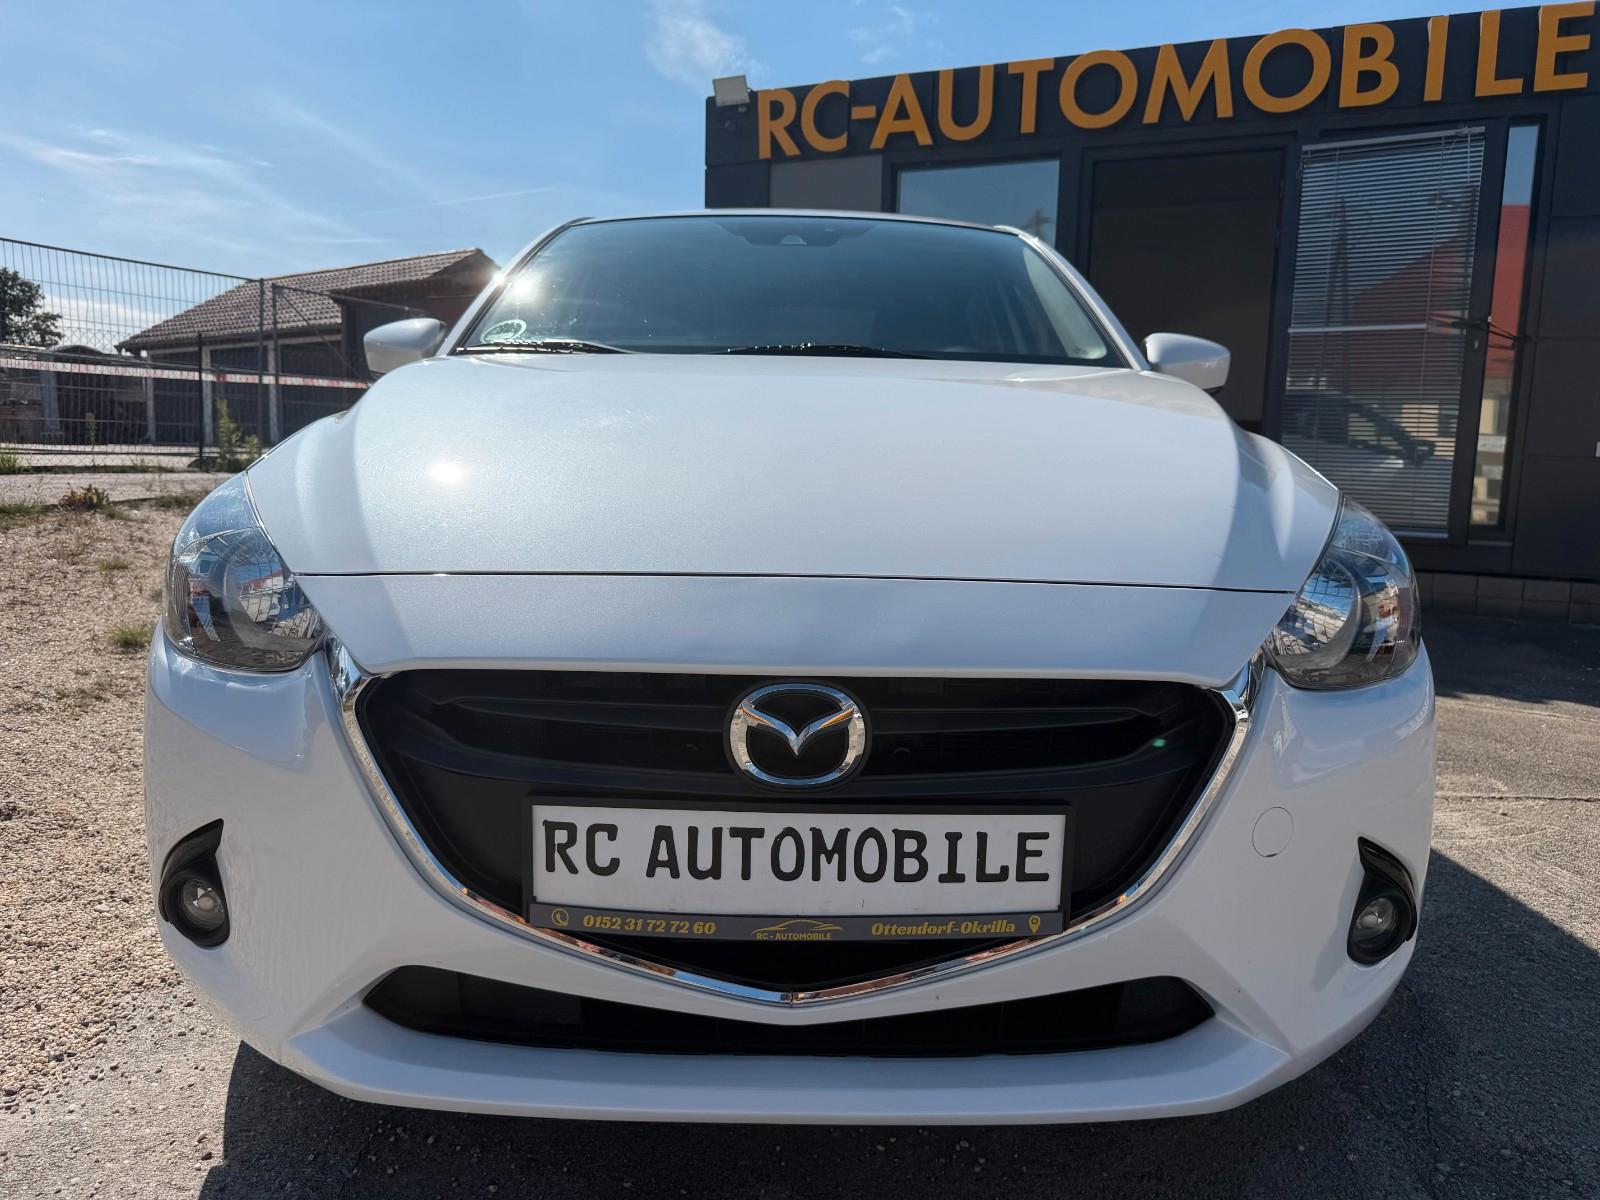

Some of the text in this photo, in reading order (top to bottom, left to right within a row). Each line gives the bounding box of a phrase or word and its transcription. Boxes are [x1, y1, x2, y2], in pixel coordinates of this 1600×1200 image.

[757, 3, 1595, 160] RC-AUTOMOBILE
[542, 819, 1050, 884] RC AUTOMOBILE
[583, 914, 716, 935] 0152 31 72 72 60
[871, 919, 1016, 936] Ottendorf-Okrilla
[756, 932, 769, 940] RC
[775, 933, 833, 941] AUTOMOBILE
